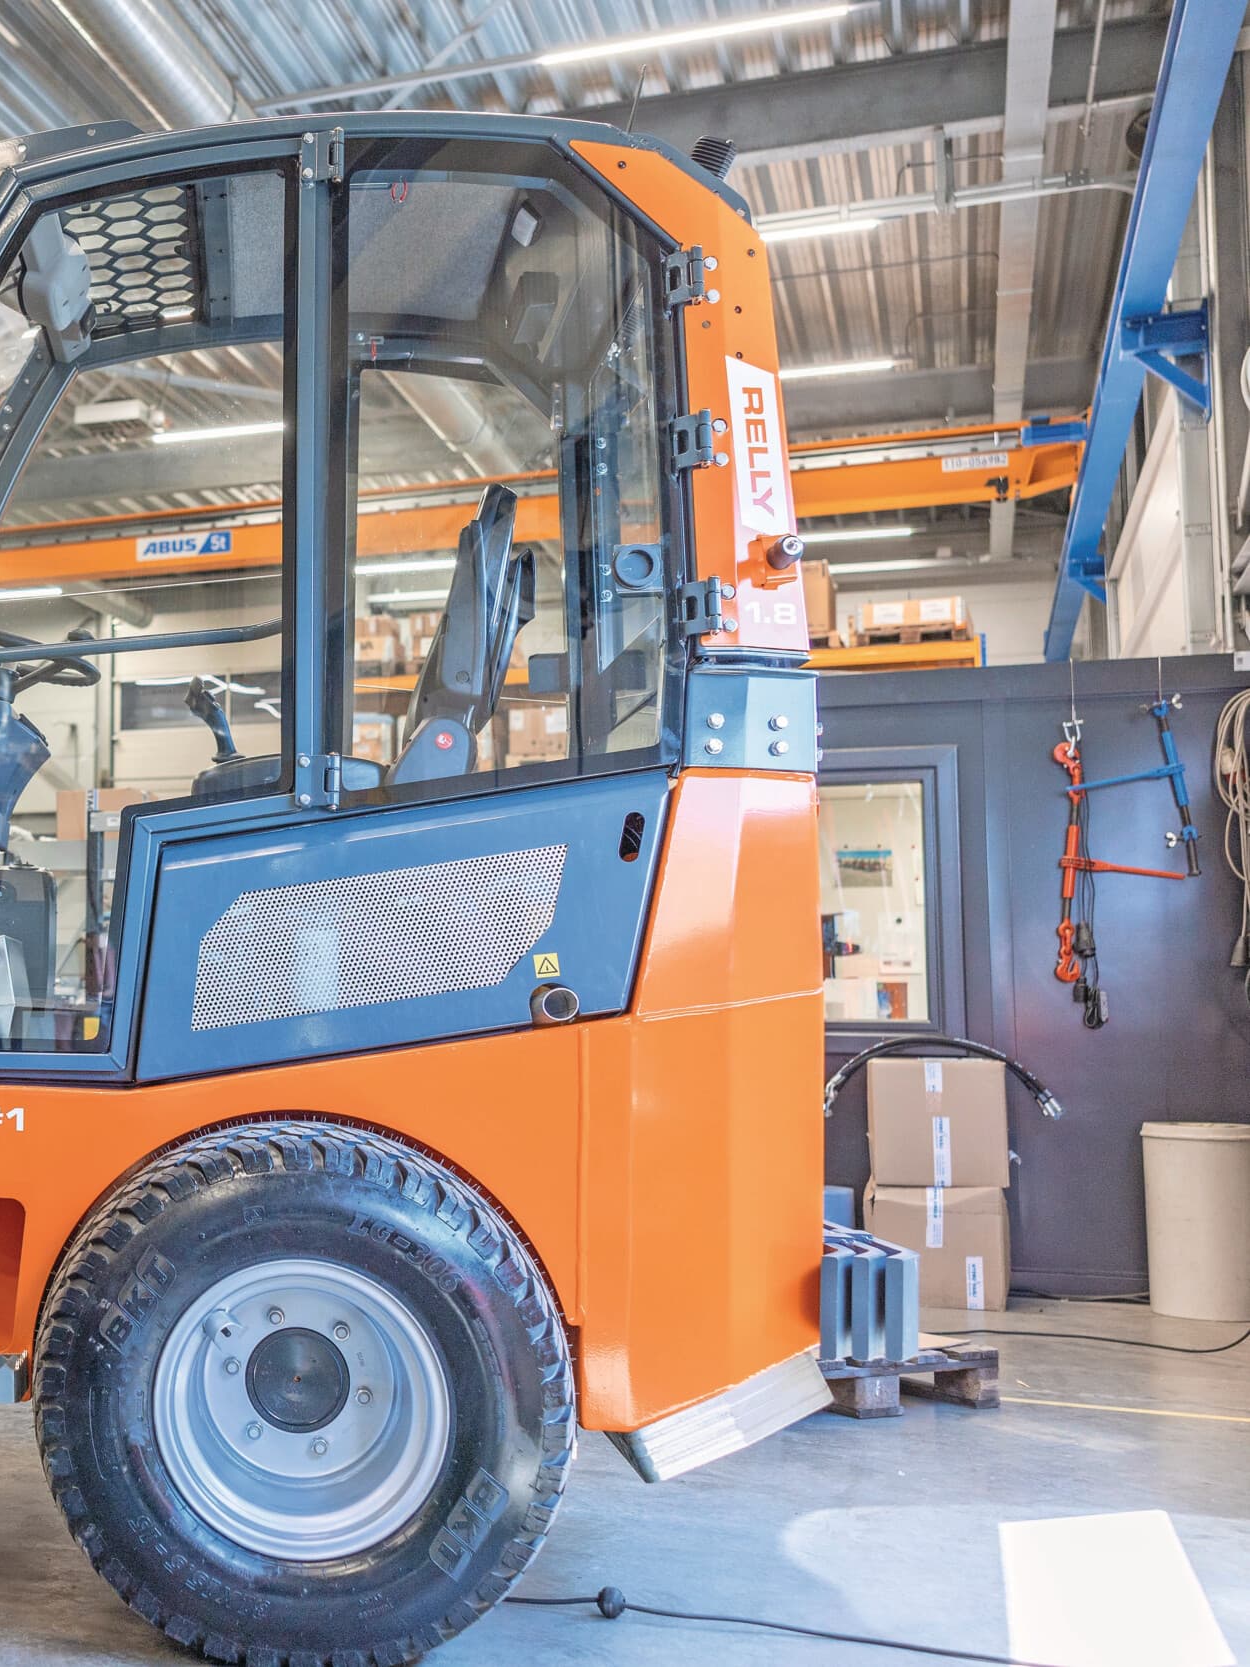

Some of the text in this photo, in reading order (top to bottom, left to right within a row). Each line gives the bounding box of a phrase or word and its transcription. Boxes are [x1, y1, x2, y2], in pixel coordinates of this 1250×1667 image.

[742, 387, 774, 516] RELLY
[143, 538, 196, 556] ABUS
[745, 602, 797, 625] 1.8
[99, 1243, 177, 1355] BKT
[348, 1211, 463, 1292] LG-306
[429, 1467, 509, 1581] BKT
